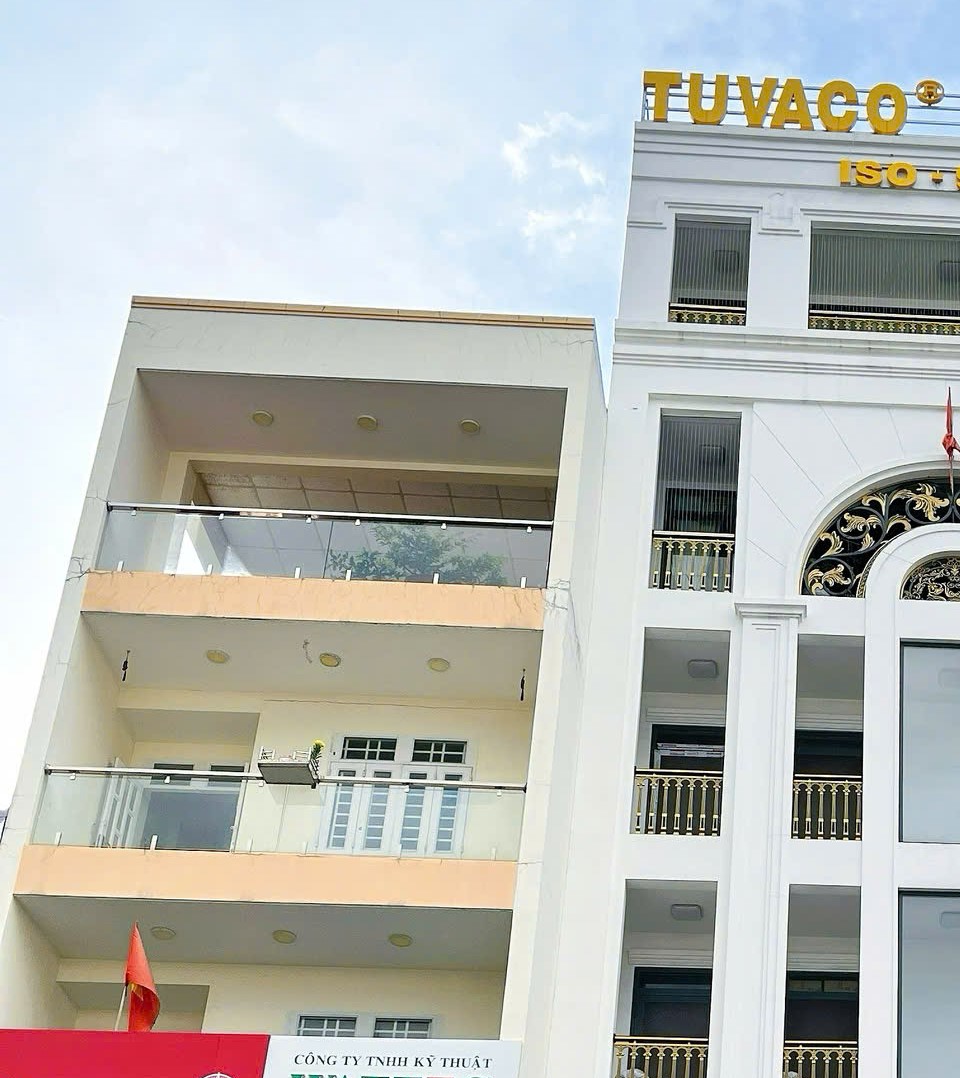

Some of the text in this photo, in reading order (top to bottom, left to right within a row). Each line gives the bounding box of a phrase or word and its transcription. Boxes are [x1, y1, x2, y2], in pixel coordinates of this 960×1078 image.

[643, 71, 908, 135] TUVACO
[839, 157, 917, 188] ISO
[294, 1051, 493, 1070] CÔNG TY TNHH KỸ THUẬT
